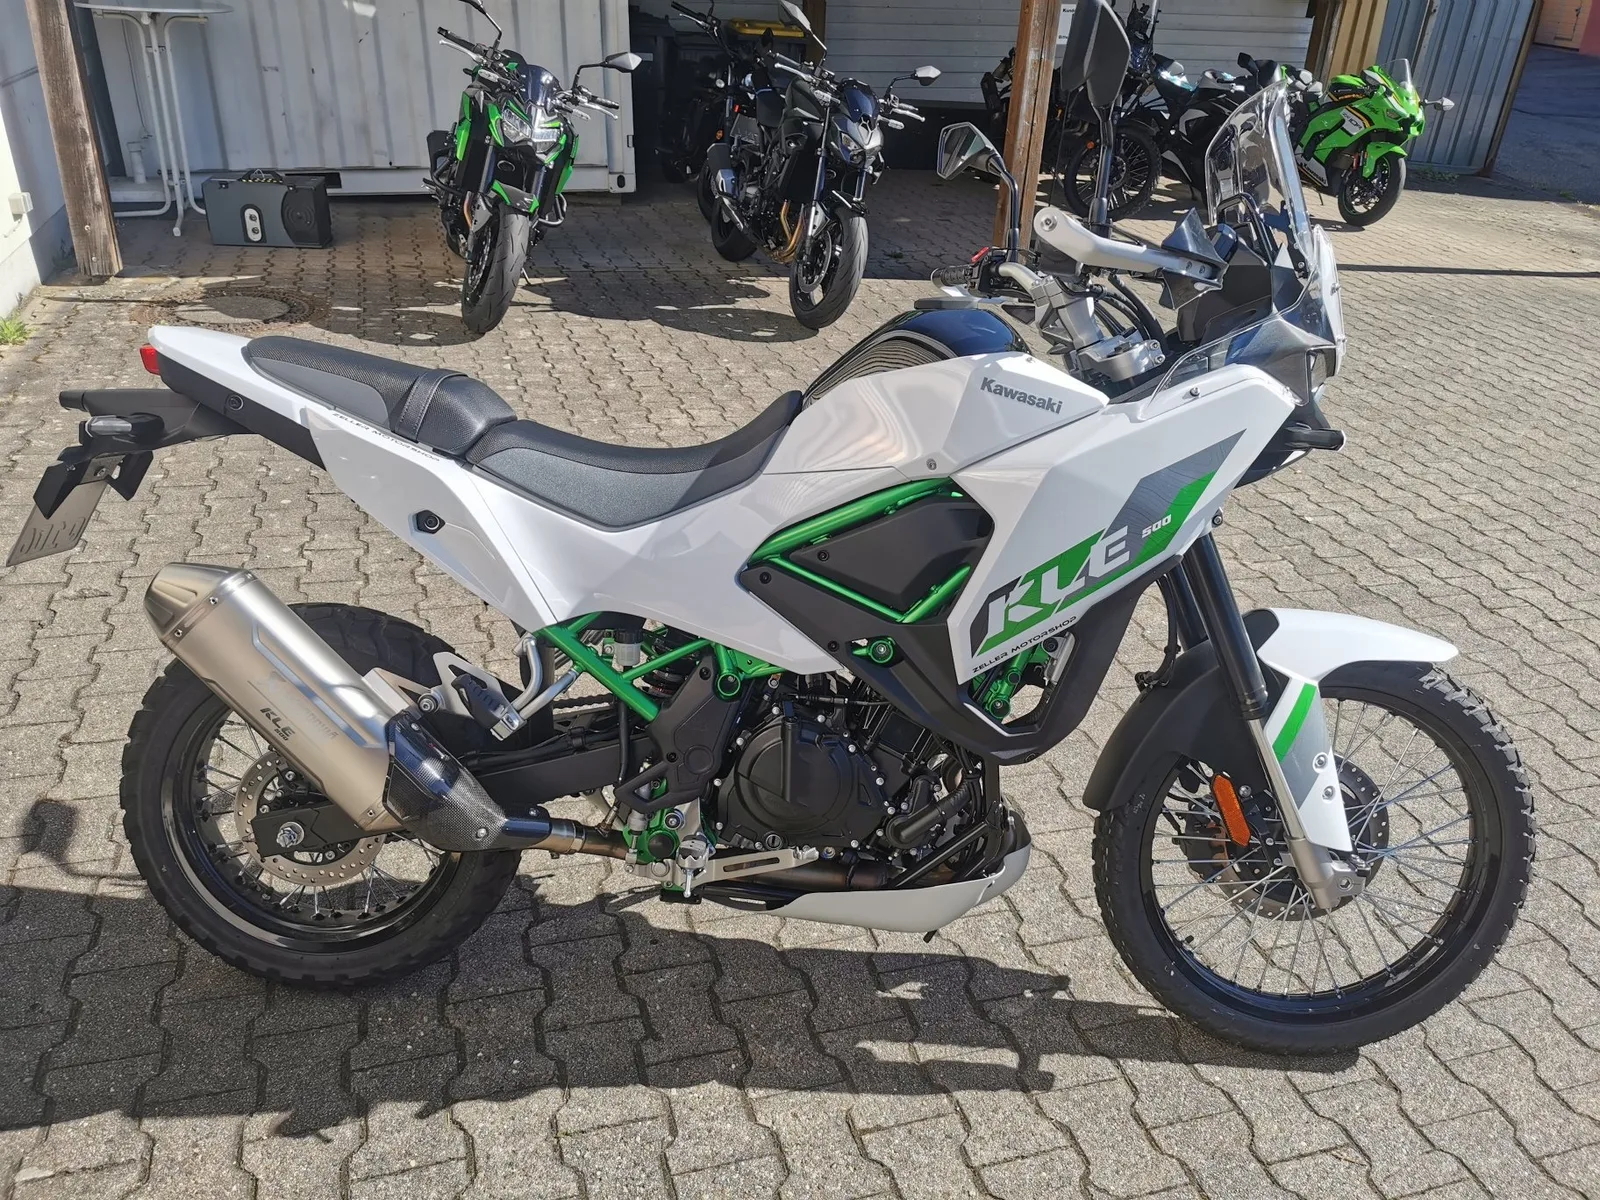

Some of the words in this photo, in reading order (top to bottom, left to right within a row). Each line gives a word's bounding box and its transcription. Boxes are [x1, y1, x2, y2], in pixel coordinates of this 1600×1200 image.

[980, 377, 1063, 414] Kawasaki
[332, 411, 370, 432] ZELLER
[371, 430, 440, 462] MOTORSHOP
[1141, 514, 1172, 539] 500
[986, 525, 1130, 636] KLE
[972, 652, 1008, 674] ZELLER
[1011, 615, 1077, 654] MOTORSHOP
[260, 707, 295, 738] KLE
